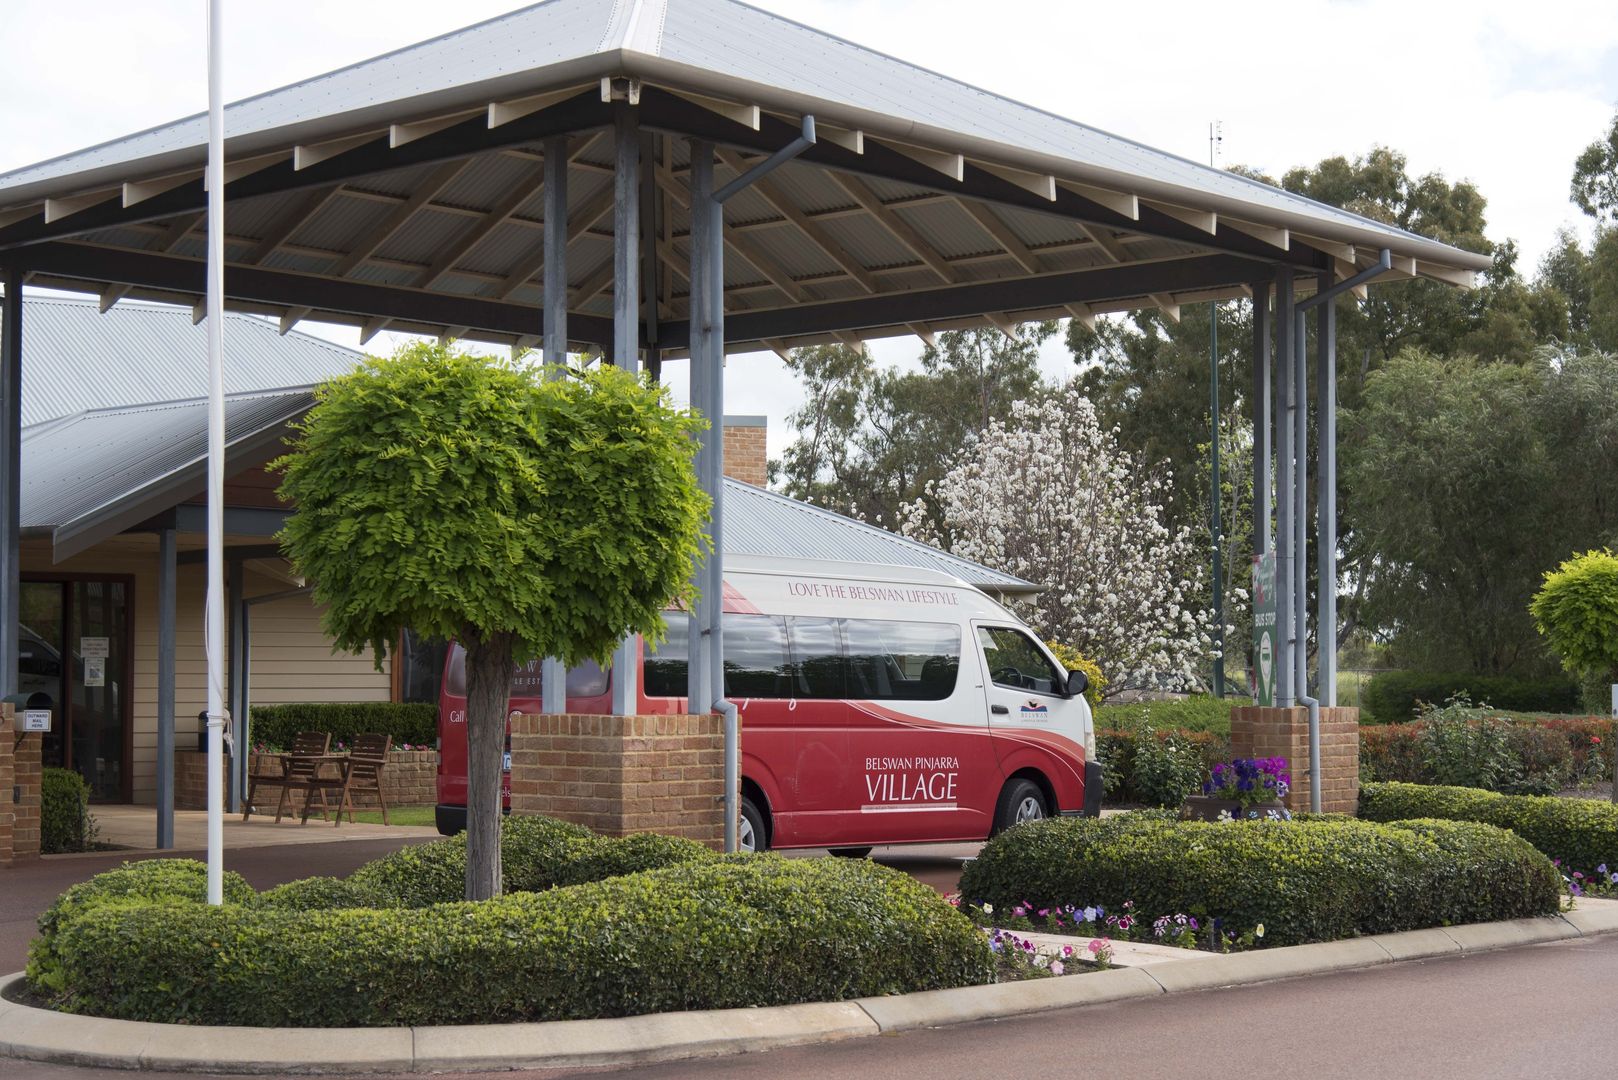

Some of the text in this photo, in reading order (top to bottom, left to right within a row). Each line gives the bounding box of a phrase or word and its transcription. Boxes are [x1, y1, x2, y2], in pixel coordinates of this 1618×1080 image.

[788, 582, 959, 606] LOVE THE BELSWAN LIFESTYLE
[1255, 612, 1276, 627] BUS STOP
[450, 710, 464, 723] Call
[865, 757, 959, 771] BELSWAN PINJARRA
[865, 772, 958, 801] VILLAGE
